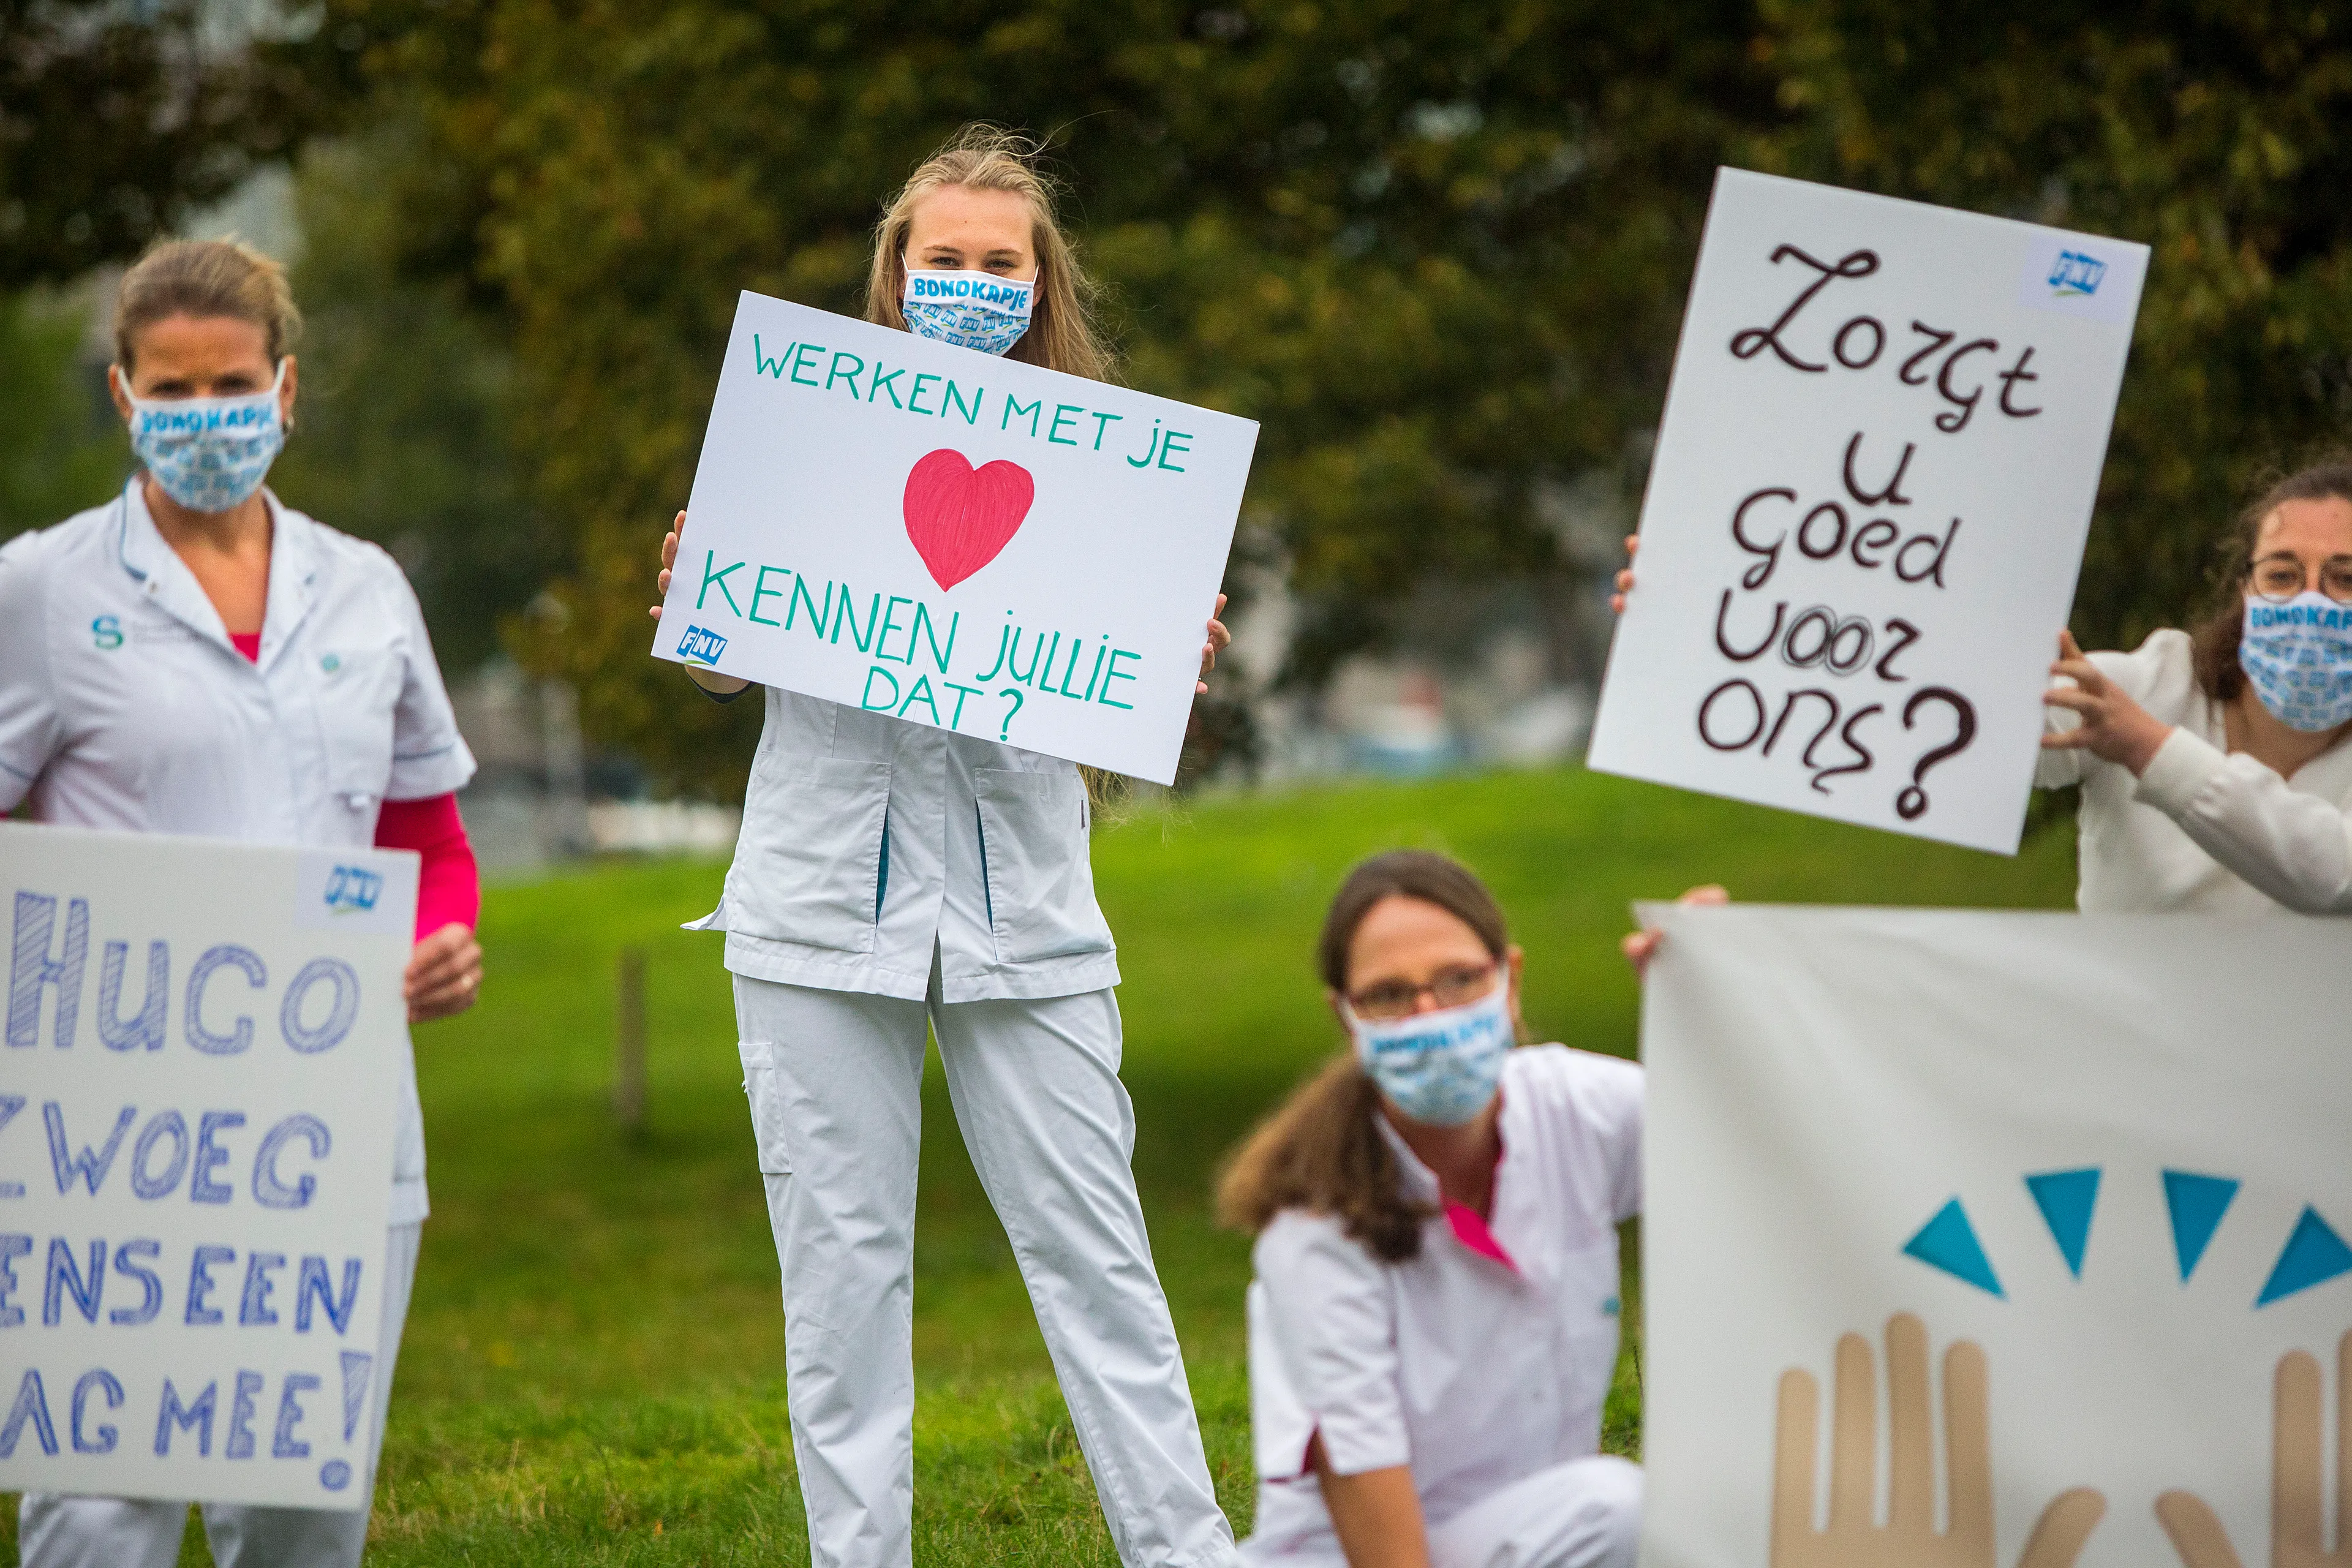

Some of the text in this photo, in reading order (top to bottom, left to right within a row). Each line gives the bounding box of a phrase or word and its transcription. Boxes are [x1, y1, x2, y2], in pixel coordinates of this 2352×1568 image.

[914, 278, 1028, 311] BONDKAPJE
[941, 310, 957, 326] FNV
[960, 317, 979, 331] FNV
[982, 317, 995, 330] FNV
[946, 333, 964, 345] FNV
[967, 337, 987, 350] FNV
[753, 333, 984, 426] WERKEN
[1001, 393, 1123, 451] MET
[696, 549, 960, 674] KENNEN
[678, 628, 728, 662] FNV
